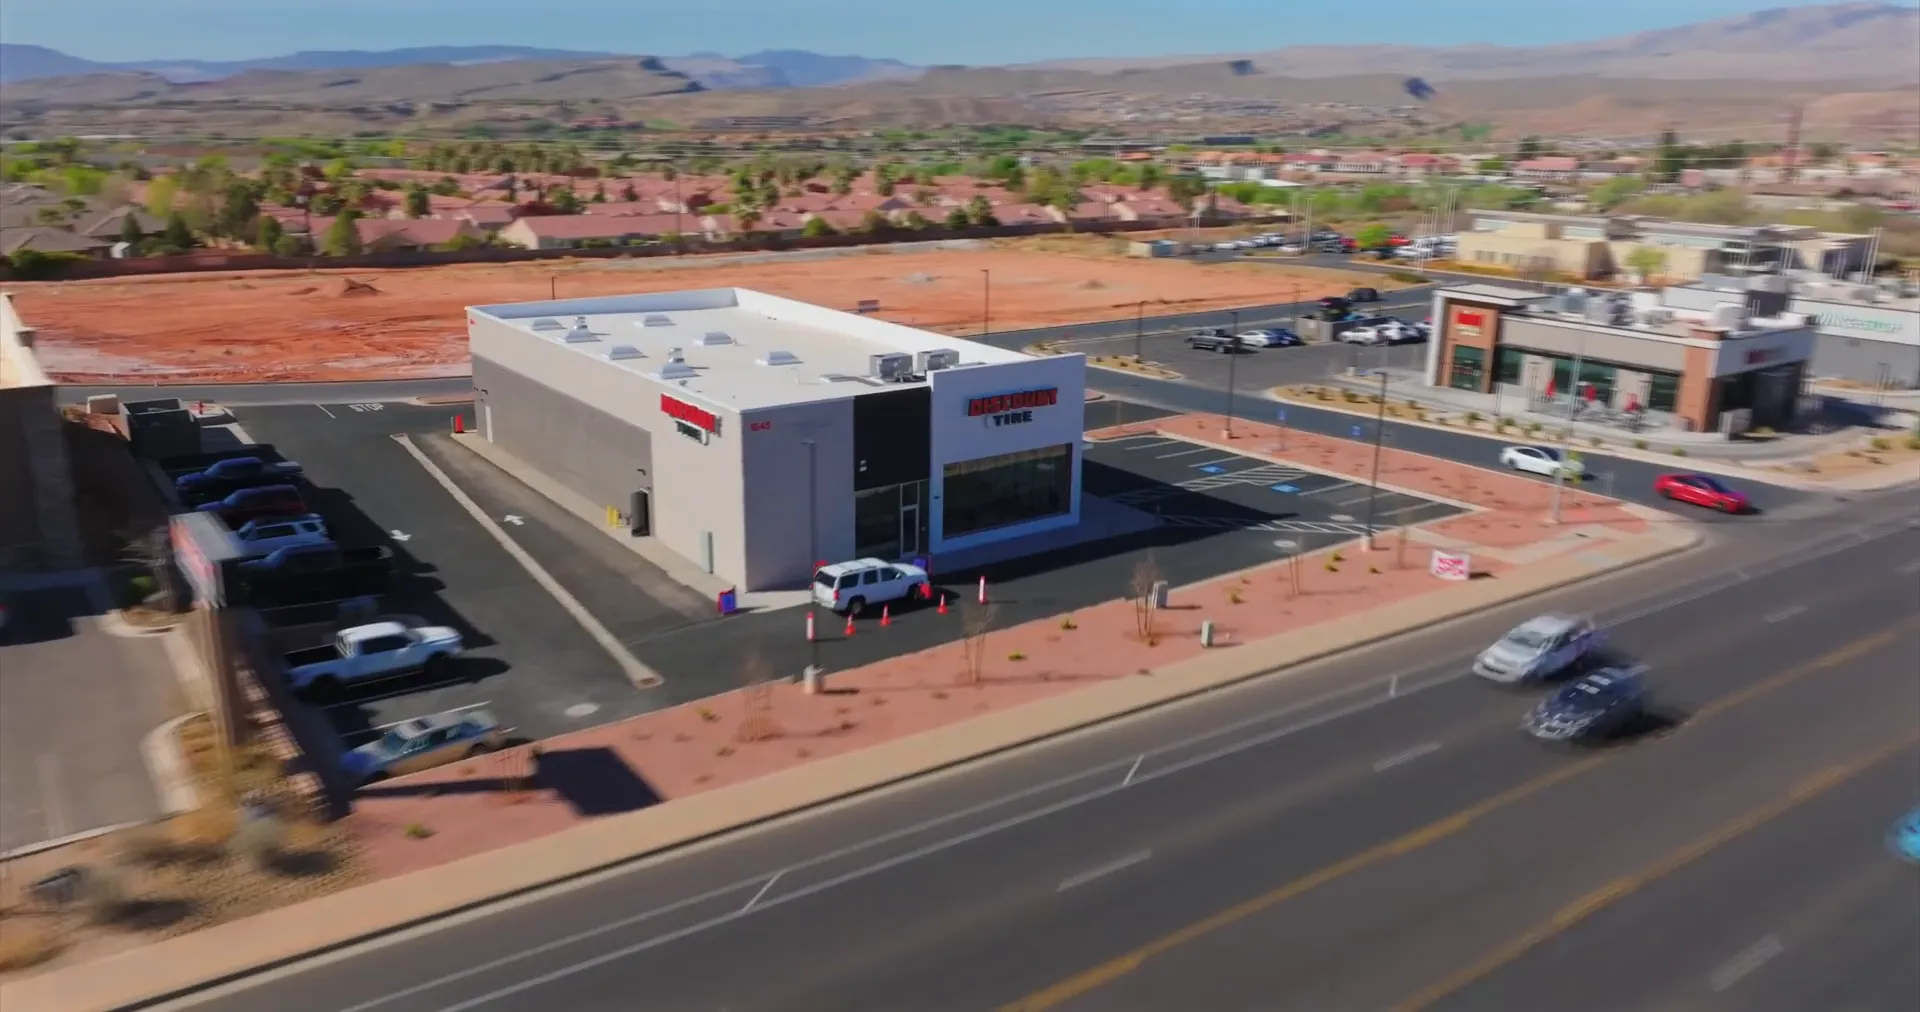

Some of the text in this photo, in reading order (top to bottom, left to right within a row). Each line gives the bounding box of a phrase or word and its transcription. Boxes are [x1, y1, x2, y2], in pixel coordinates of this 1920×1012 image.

[349, 402, 384, 412] STOP
[967, 387, 1058, 416] DISCOUNT
[993, 410, 1033, 427] TIRE
